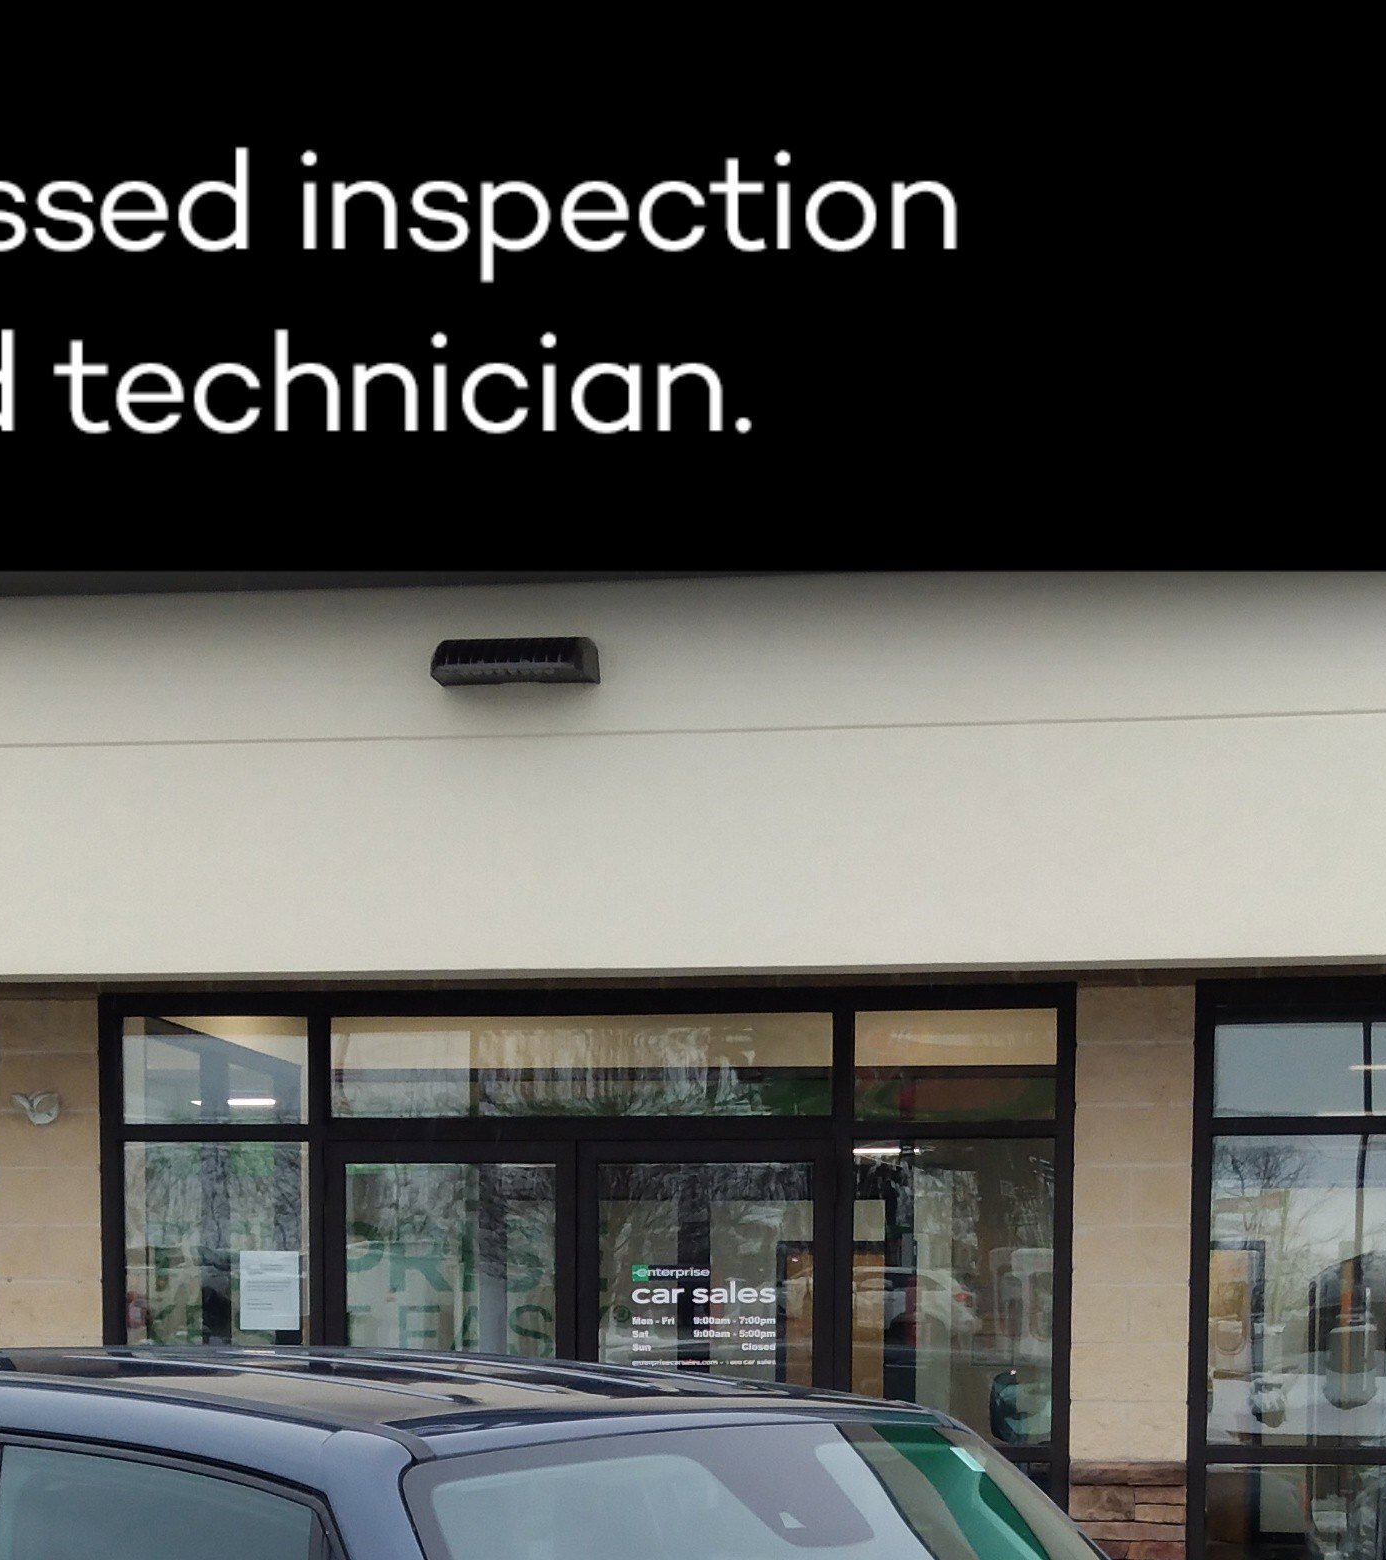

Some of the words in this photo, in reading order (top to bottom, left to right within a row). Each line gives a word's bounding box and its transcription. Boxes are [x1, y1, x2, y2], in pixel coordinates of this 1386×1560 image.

[633, 1267, 711, 1279] enterprise
[632, 1287, 685, 1304] car
[692, 1280, 776, 1304] sales
[632, 1316, 653, 1325] Mon
[661, 1316, 675, 1325] Fri
[739, 1316, 776, 1326] 7:00pm
[632, 1330, 649, 1338] Sat
[693, 1329, 731, 1338] 9:00am
[739, 1329, 776, 1339] 5:00pm
[632, 1343, 652, 1351] Sun
[741, 1343, 776, 1351] Closed
